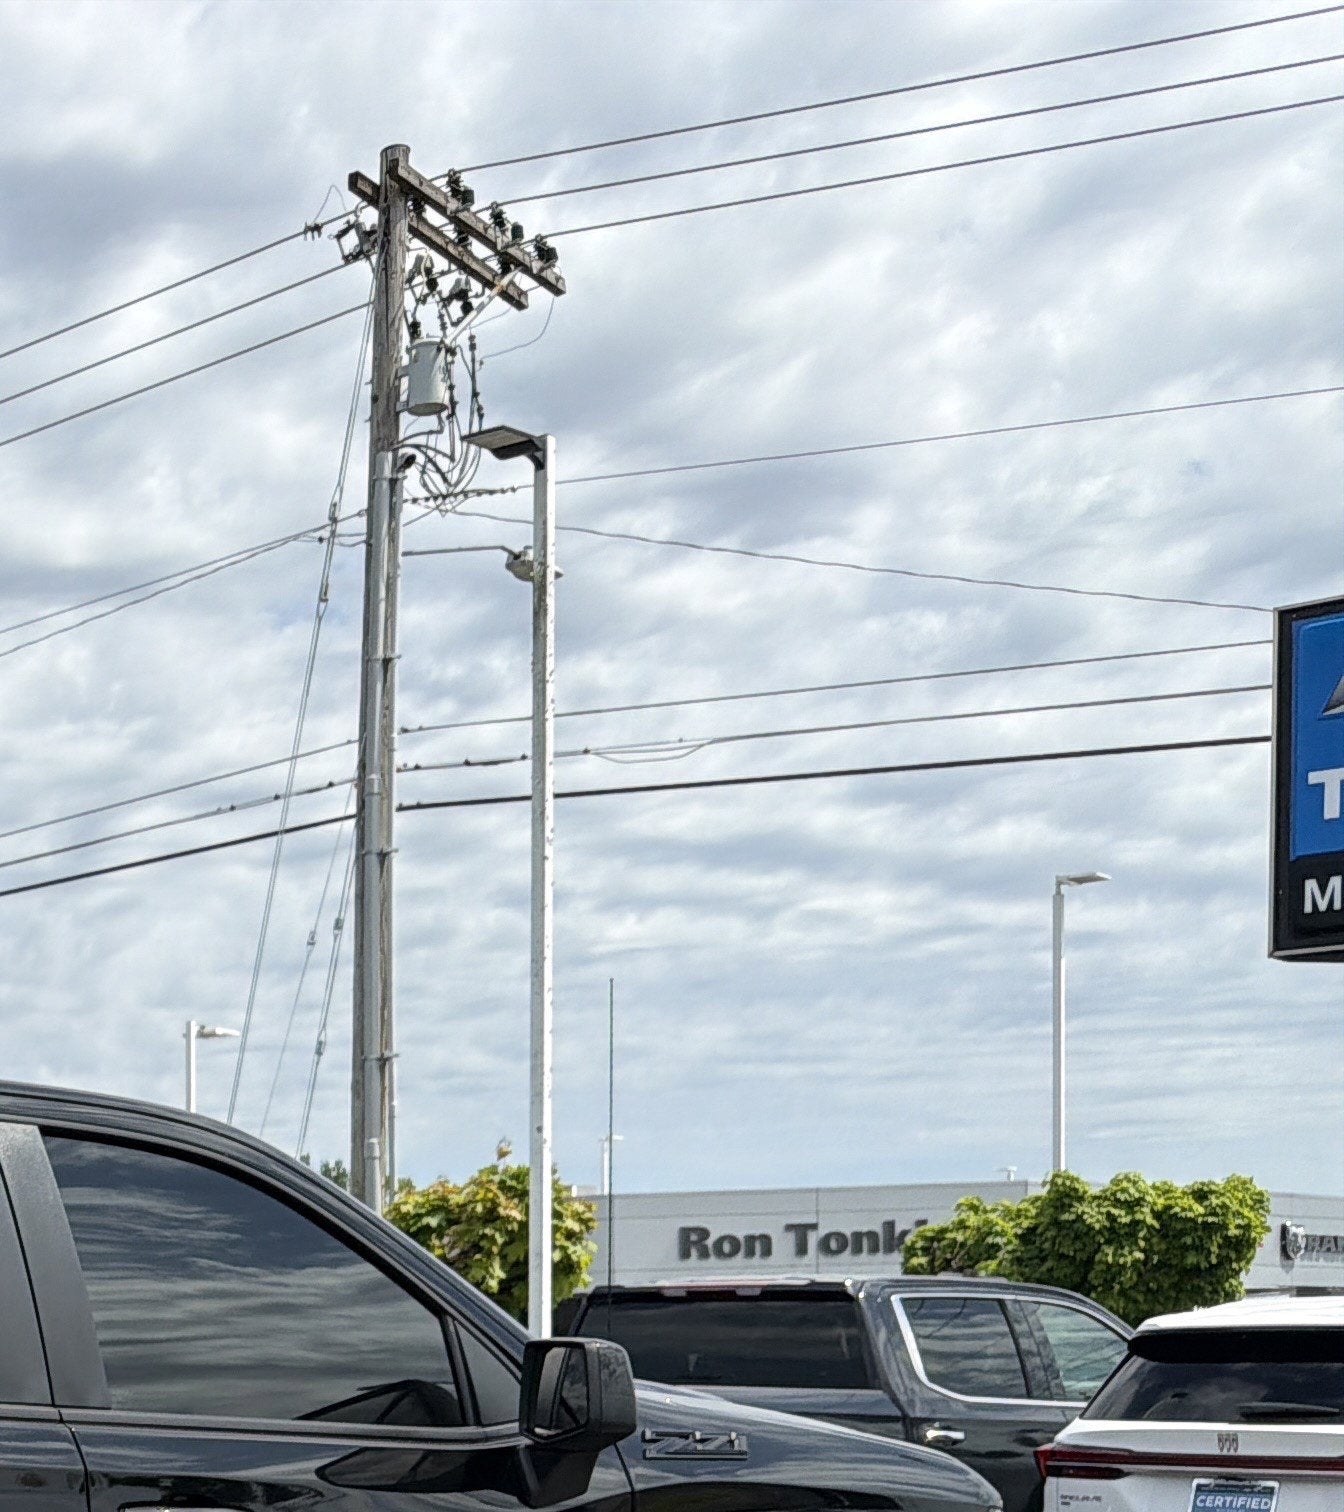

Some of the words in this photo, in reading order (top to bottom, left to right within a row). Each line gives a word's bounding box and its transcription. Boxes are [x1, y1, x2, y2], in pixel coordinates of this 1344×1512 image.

[678, 1225, 773, 1261] Ron
[784, 1218, 929, 1258] Tonk
[1196, 1495, 1272, 1510] CERTIFIED
